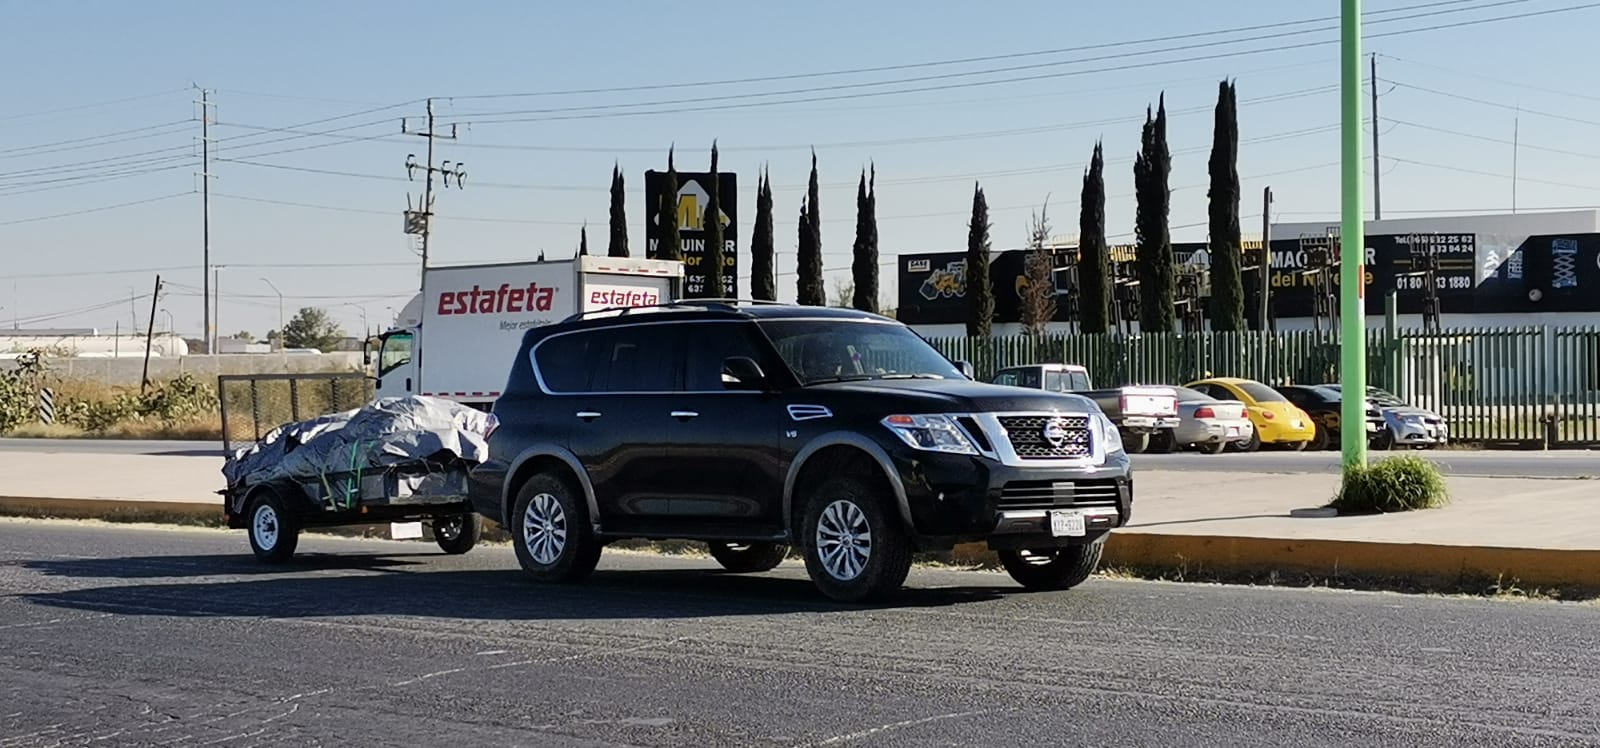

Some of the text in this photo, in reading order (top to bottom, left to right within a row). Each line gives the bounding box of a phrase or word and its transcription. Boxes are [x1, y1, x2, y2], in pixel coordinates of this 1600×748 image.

[1271, 271, 1296, 287] del
[1396, 277, 1408, 289] 01
[1449, 276, 1471, 288] 1880
[438, 282, 552, 315] estafeta
[590, 290, 656, 306] estafeta
